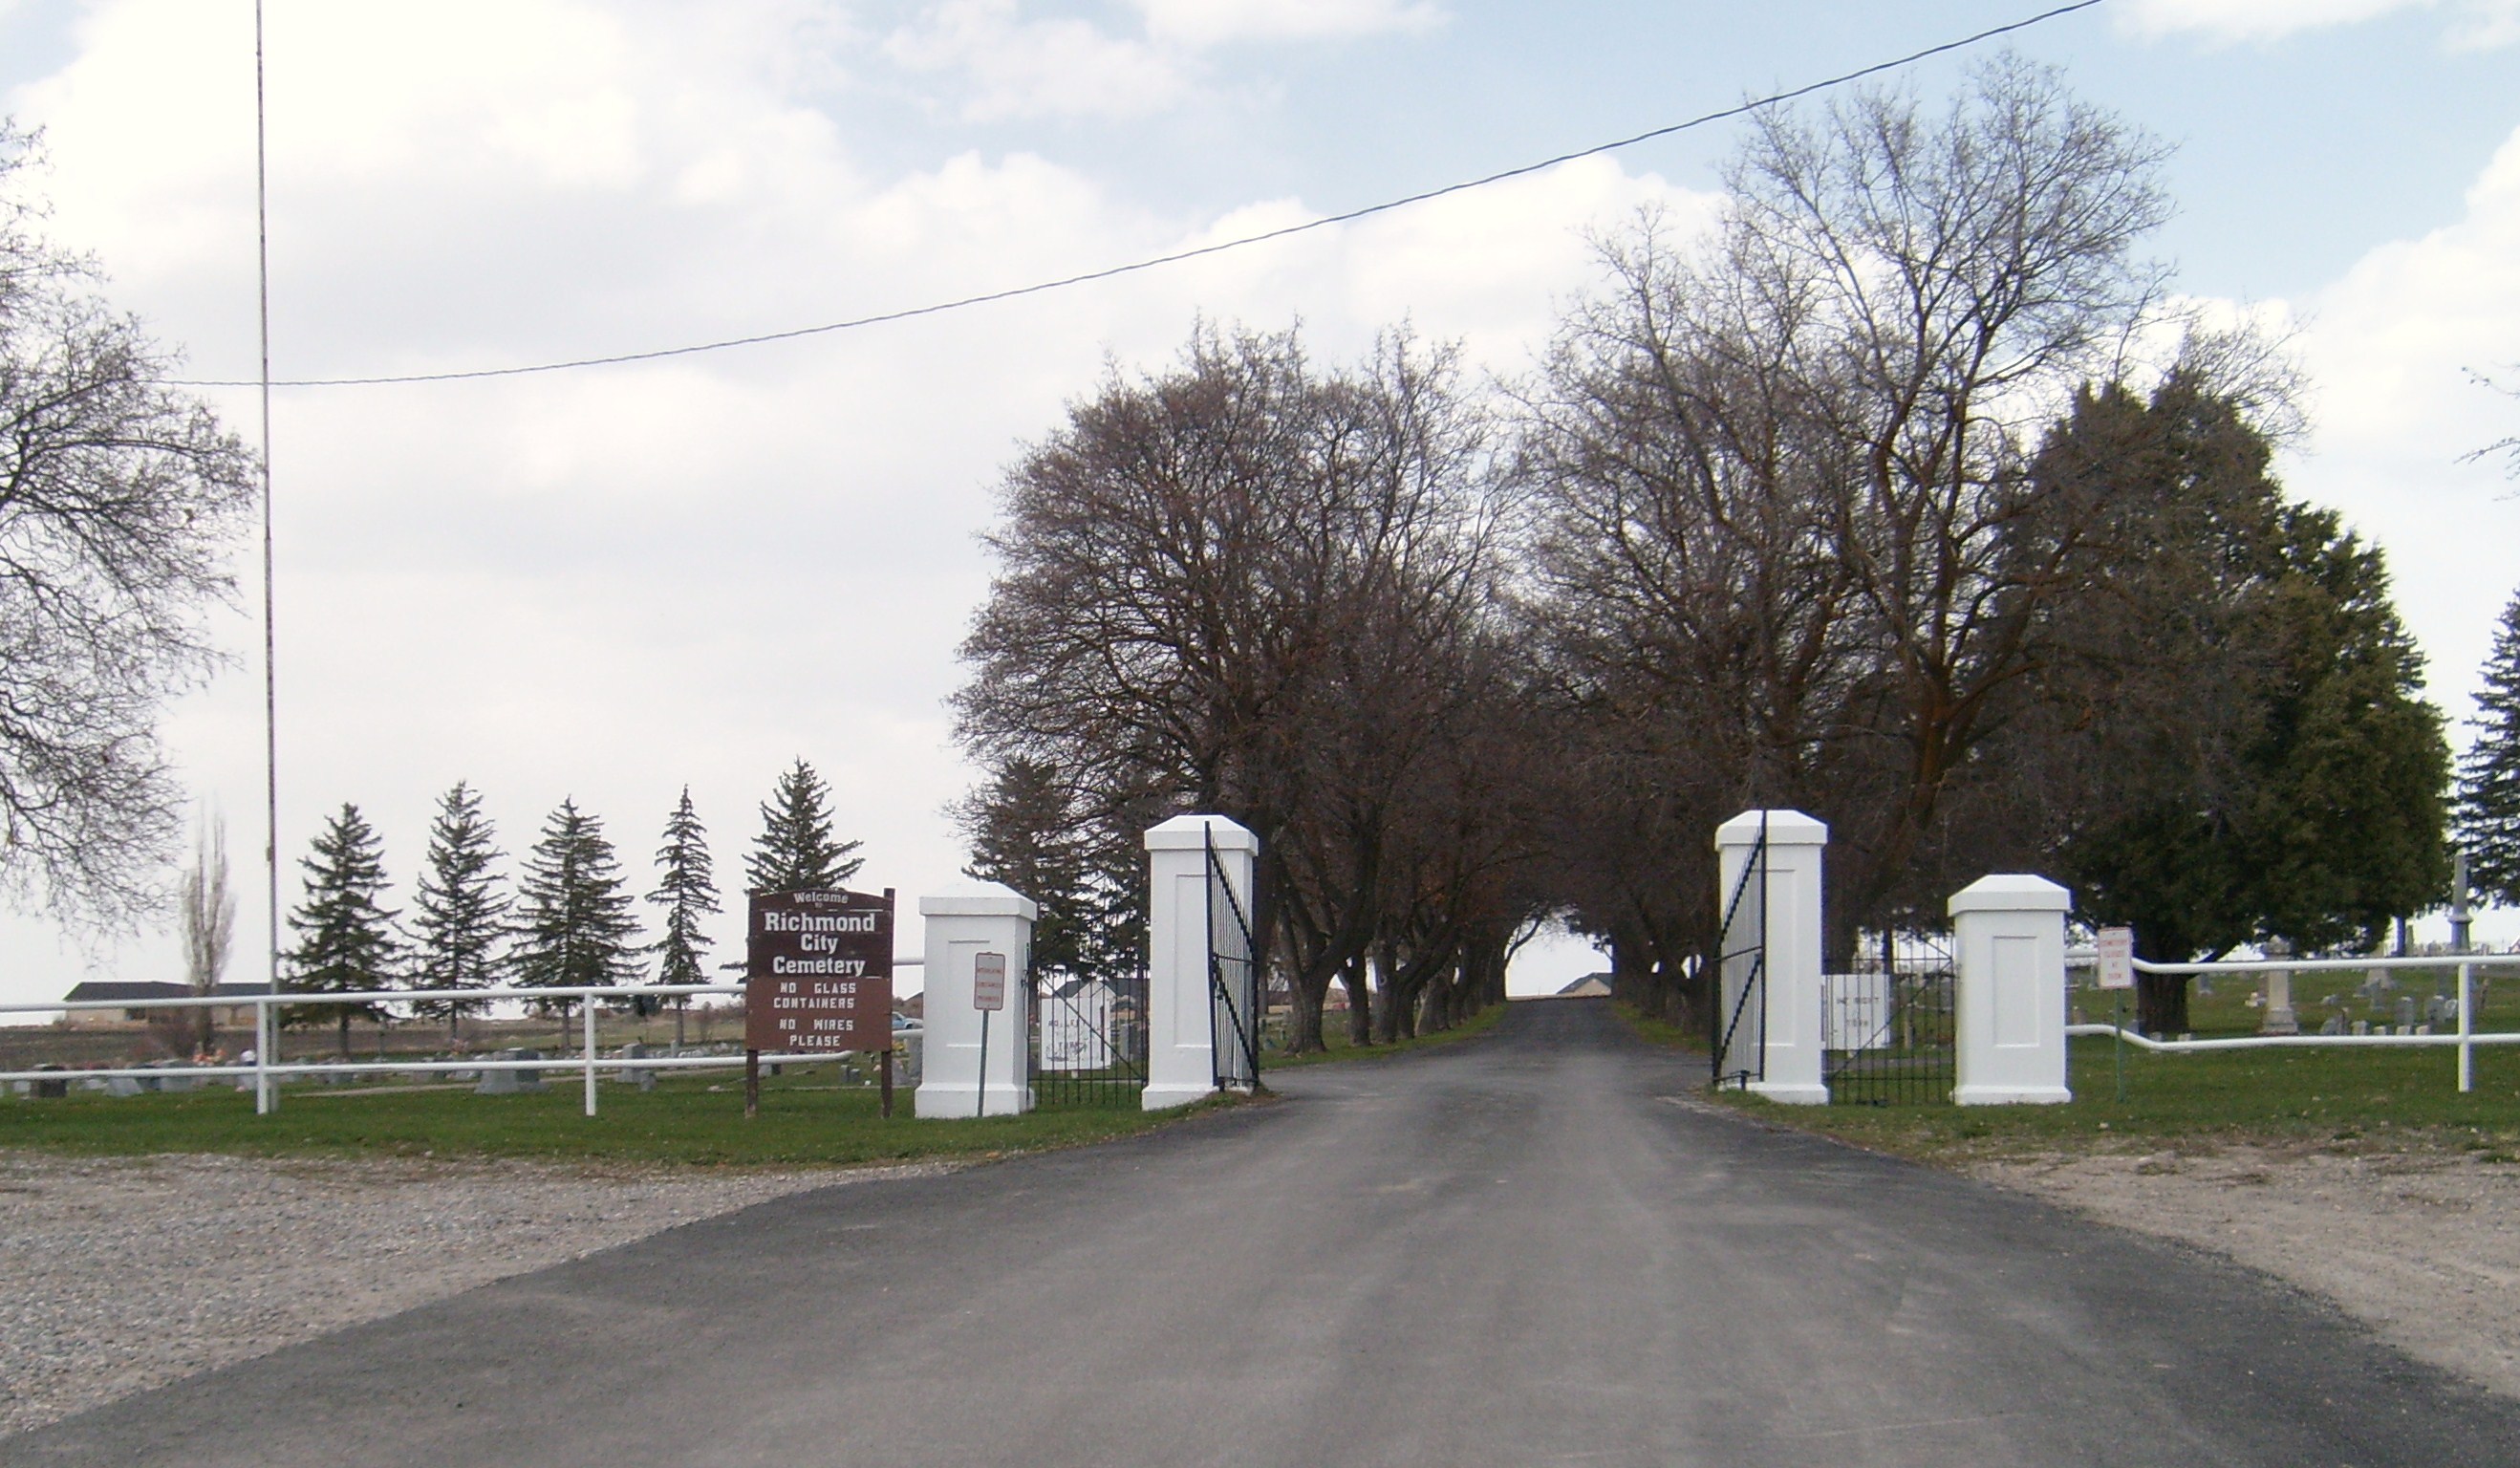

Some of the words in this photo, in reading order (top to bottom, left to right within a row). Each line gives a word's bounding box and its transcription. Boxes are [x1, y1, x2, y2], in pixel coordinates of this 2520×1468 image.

[793, 891, 849, 904] Welcome
[765, 912, 875, 932] Richmond
[801, 933, 839, 954] City
[773, 956, 866, 977] Cemetery
[780, 982, 797, 994] NO
[814, 982, 856, 994] GLASS
[773, 997, 855, 1009] CONTAINERS
[779, 1019, 796, 1030] NO
[813, 1019, 854, 1031] WIRES
[789, 1034, 841, 1047] PLEASE
